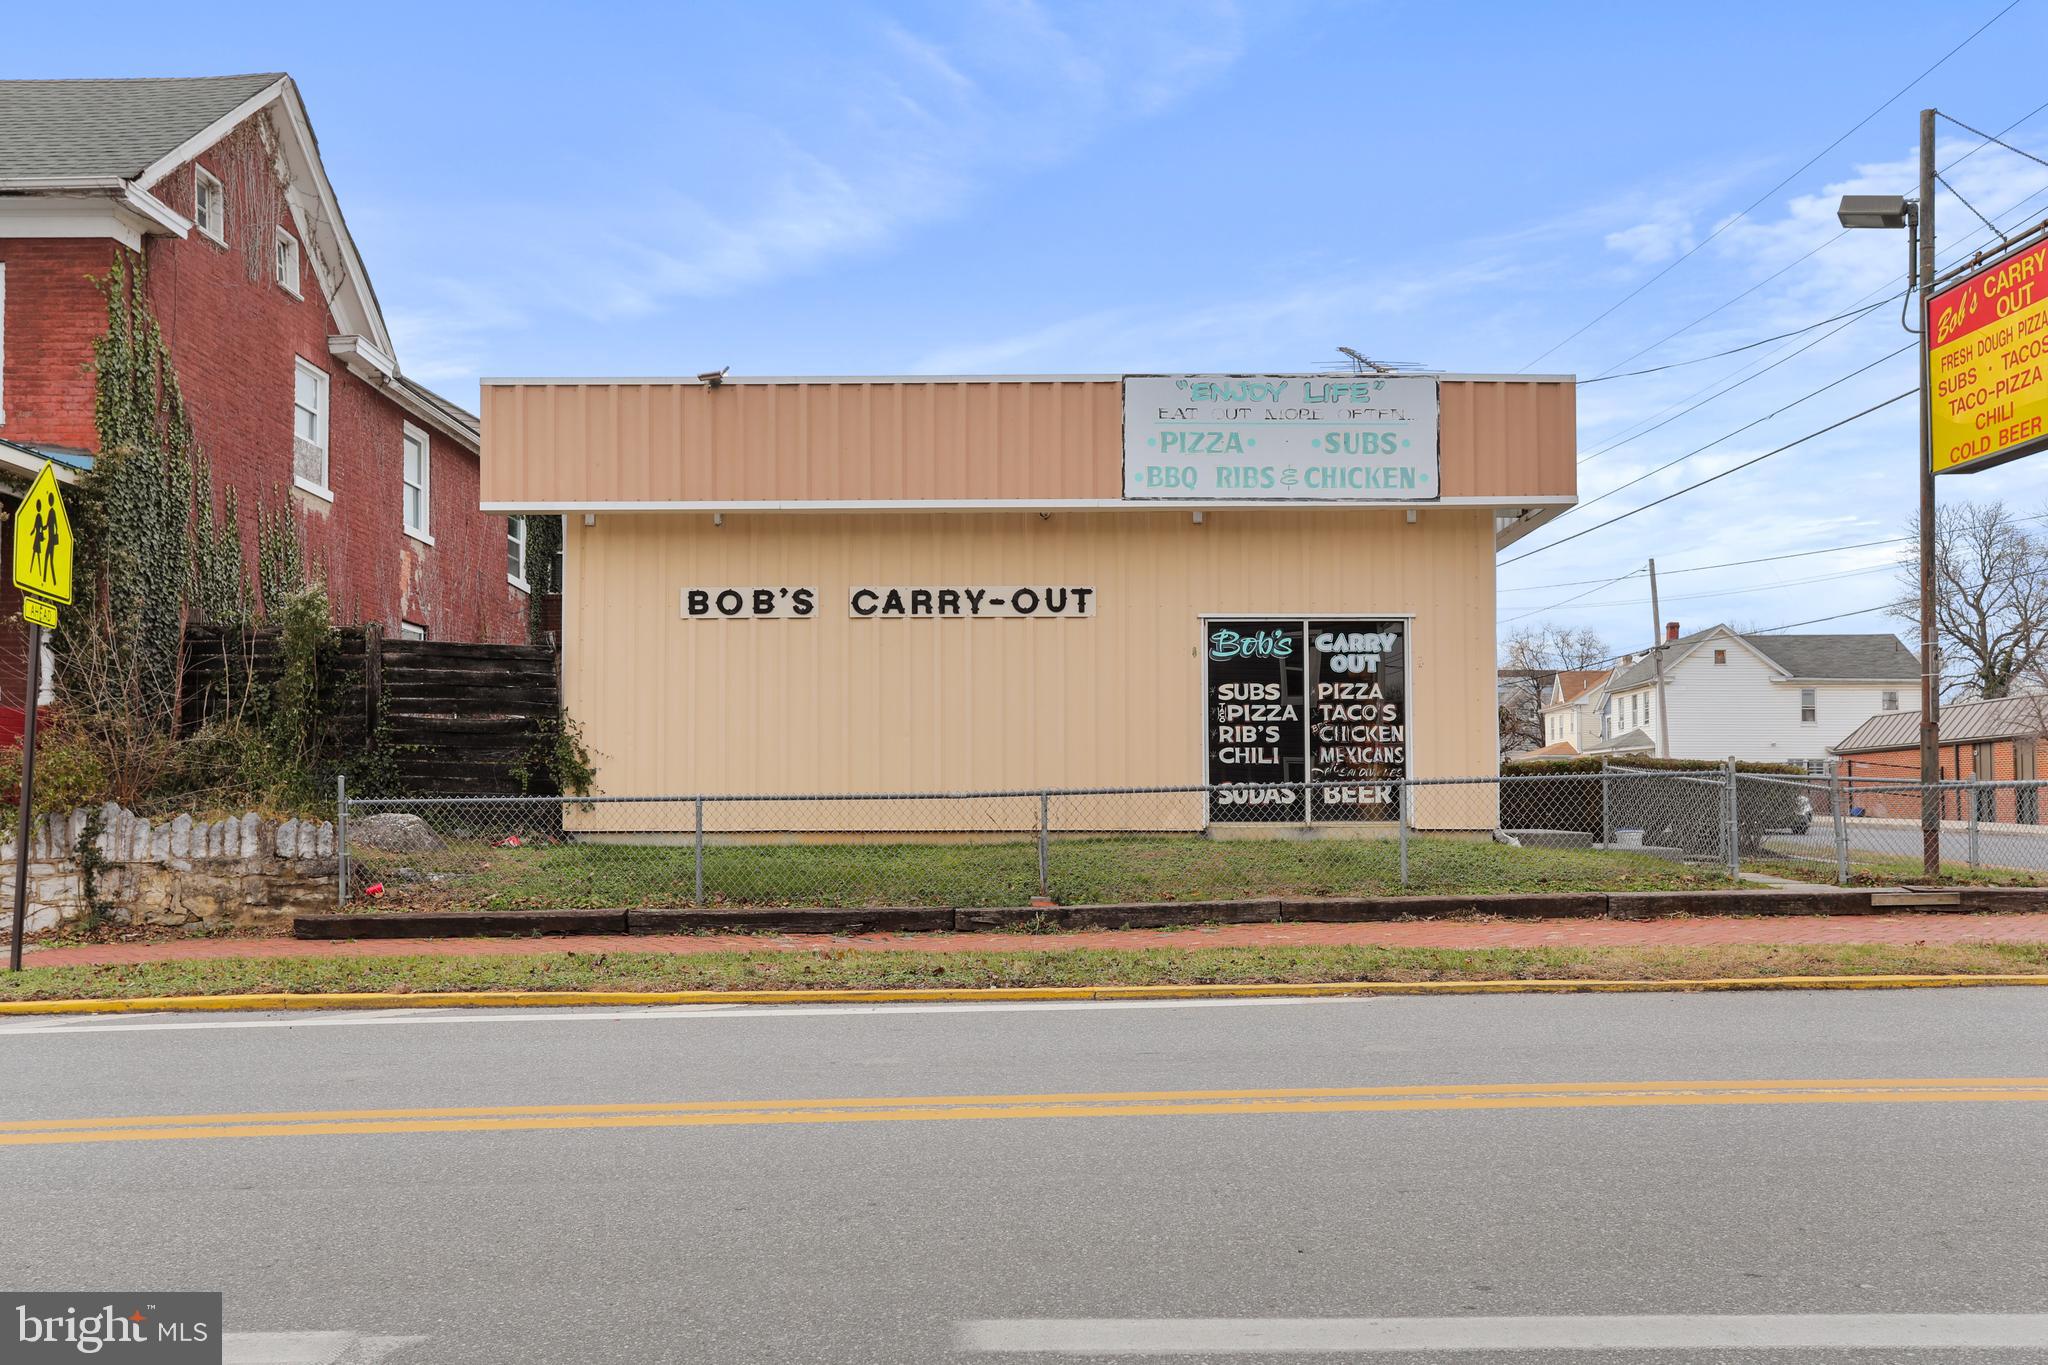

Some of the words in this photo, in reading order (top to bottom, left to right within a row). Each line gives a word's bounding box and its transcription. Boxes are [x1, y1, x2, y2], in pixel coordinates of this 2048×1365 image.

[1937, 286, 1978, 344] Bob's
[1983, 248, 2047, 298] CARRY
[1996, 281, 2035, 318] OUT
[1941, 344, 1973, 374] FRESH
[1977, 326, 2013, 357] DOUGH
[2018, 310, 2048, 339] PIZZA
[1938, 367, 1977, 398] SUBS
[1948, 366, 2043, 416] TACO-PIZZA
[1158, 407, 1200, 420] EAT
[1975, 401, 2015, 431] CHILI
[1160, 431, 1244, 454] PIZZA
[1324, 431, 1398, 455] SUBS
[1950, 435, 1991, 464] COLD
[1999, 416, 2042, 447] BEER
[1146, 465, 1198, 490] BBQ
[1216, 466, 1275, 489] RIBS
[1303, 466, 1416, 489] CHICKEN
[688, 587, 814, 615] BOB'S
[851, 587, 1093, 615] CARRY-OUT
[31, 604, 52, 622] AHEAD
[1209, 628, 1293, 661] Bob's
[1314, 632, 1398, 653] CARRY
[1330, 653, 1381, 673] OUT
[1218, 683, 1281, 700] SUBS
[1318, 683, 1384, 700] PIZZA
[1227, 704, 1298, 721] PIZZA
[1219, 725, 1280, 743] RIB'S
[1319, 725, 1404, 742] CHICKEN
[1218, 747, 1279, 764] CHILI
[1320, 746, 1405, 764] MEXICANS
[1218, 781, 1296, 804] SODAS
[1324, 783, 1392, 804] BEER
